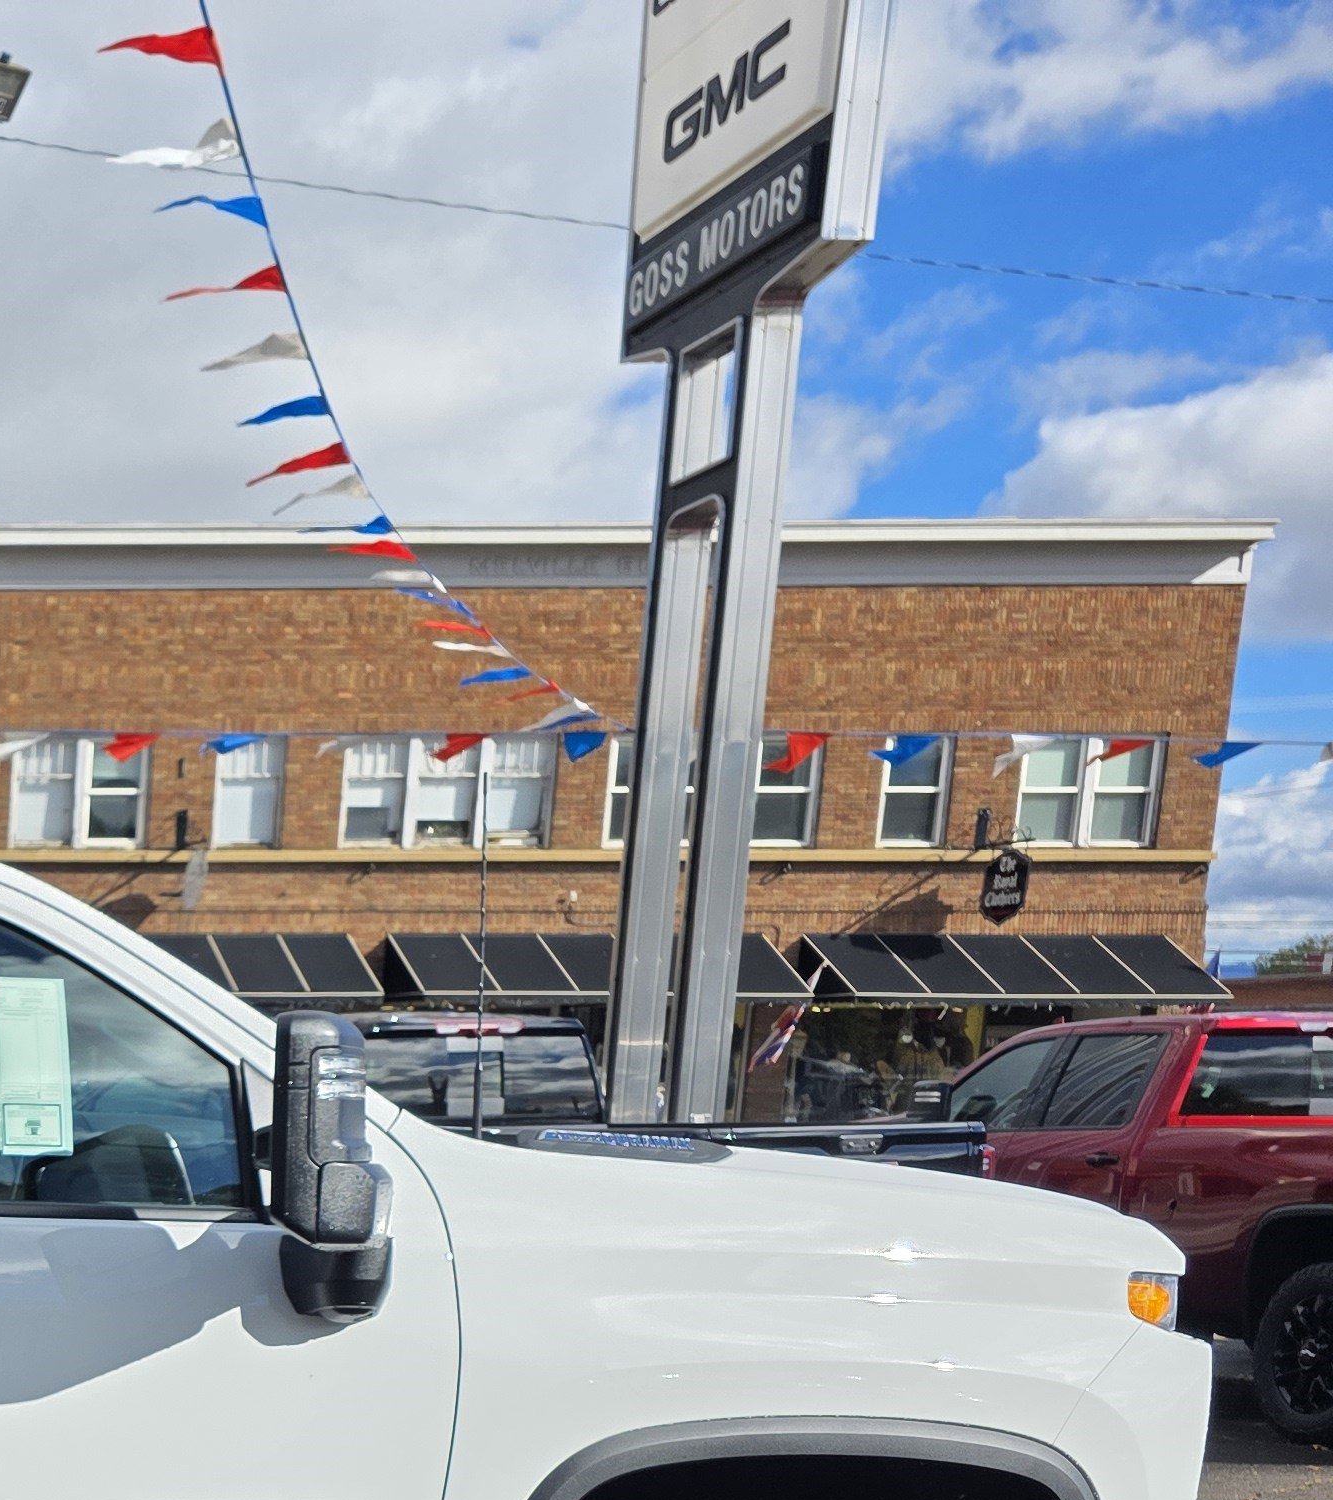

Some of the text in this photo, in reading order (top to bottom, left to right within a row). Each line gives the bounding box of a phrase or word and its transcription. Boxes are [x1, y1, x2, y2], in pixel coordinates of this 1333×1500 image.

[663, 18, 791, 164] GMC
[628, 163, 805, 317] GOSS MOTORS
